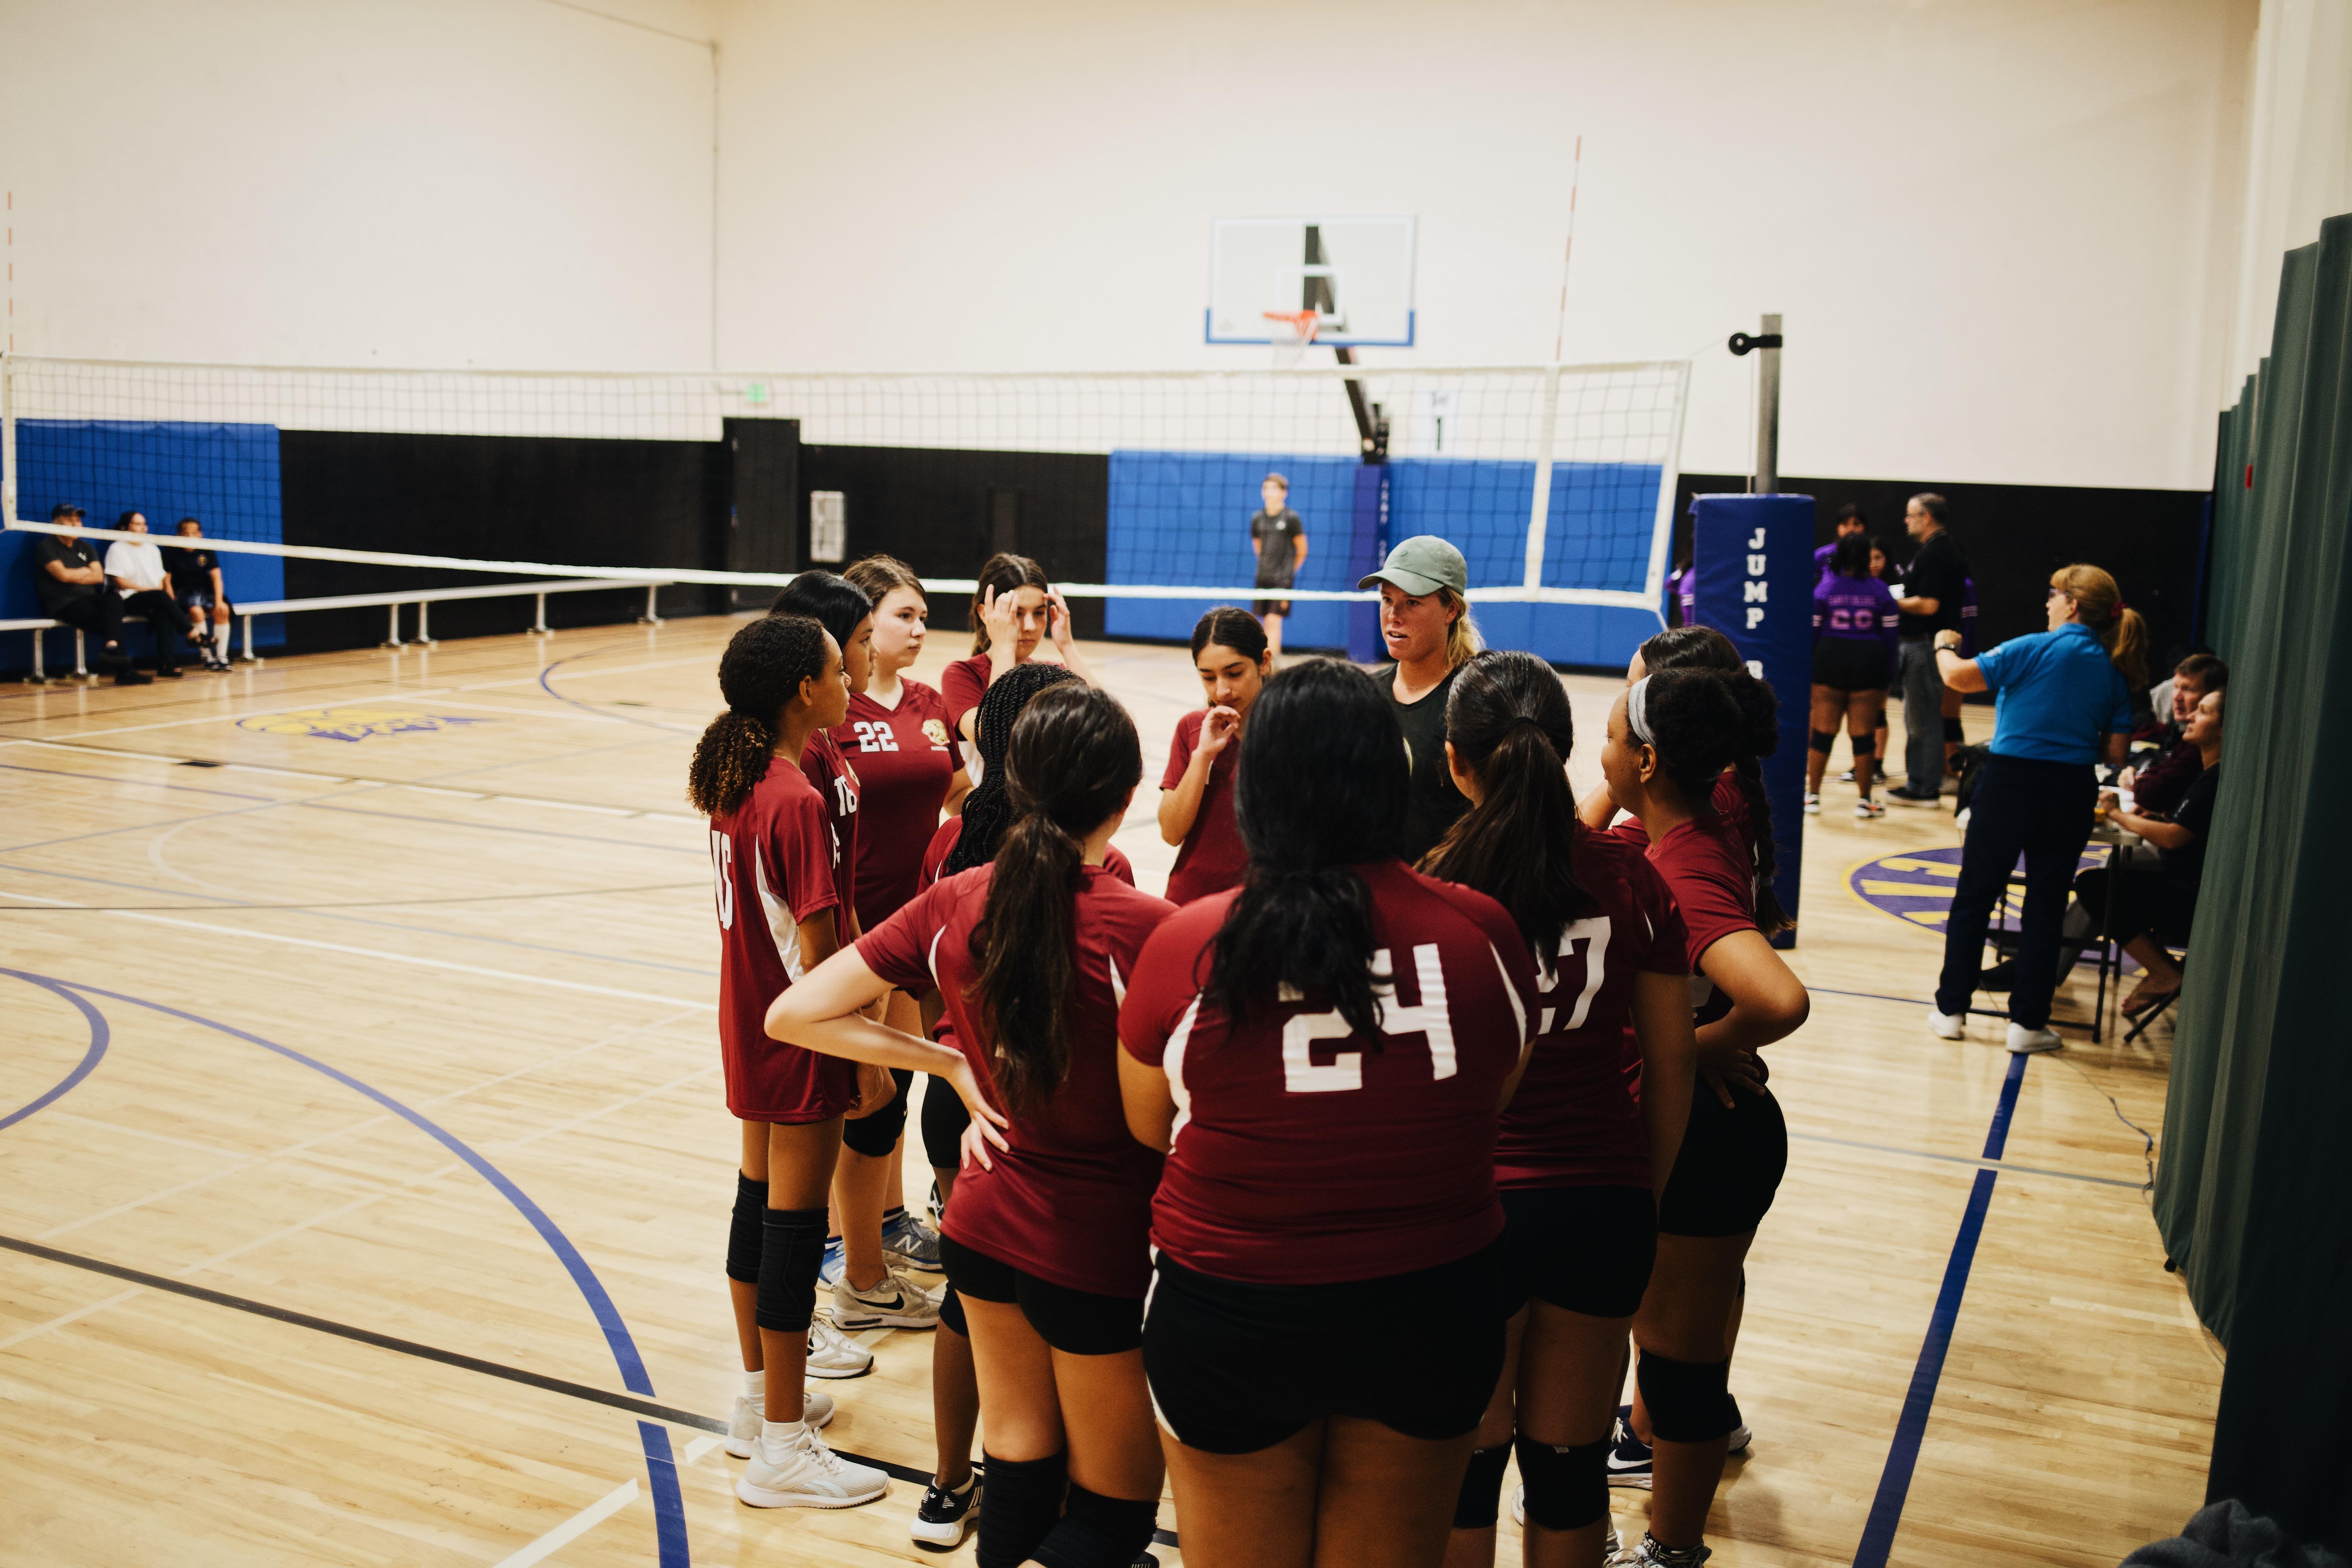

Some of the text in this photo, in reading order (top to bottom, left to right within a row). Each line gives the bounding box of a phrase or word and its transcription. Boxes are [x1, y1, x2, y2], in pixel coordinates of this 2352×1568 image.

[1744, 527, 1768, 629] JUMP
[853, 721, 899, 752] 22
[834, 775, 857, 816] 16
[711, 830, 733, 931] 15
[1278, 943, 1457, 1092] 24
[894, 1234, 922, 1254] N
